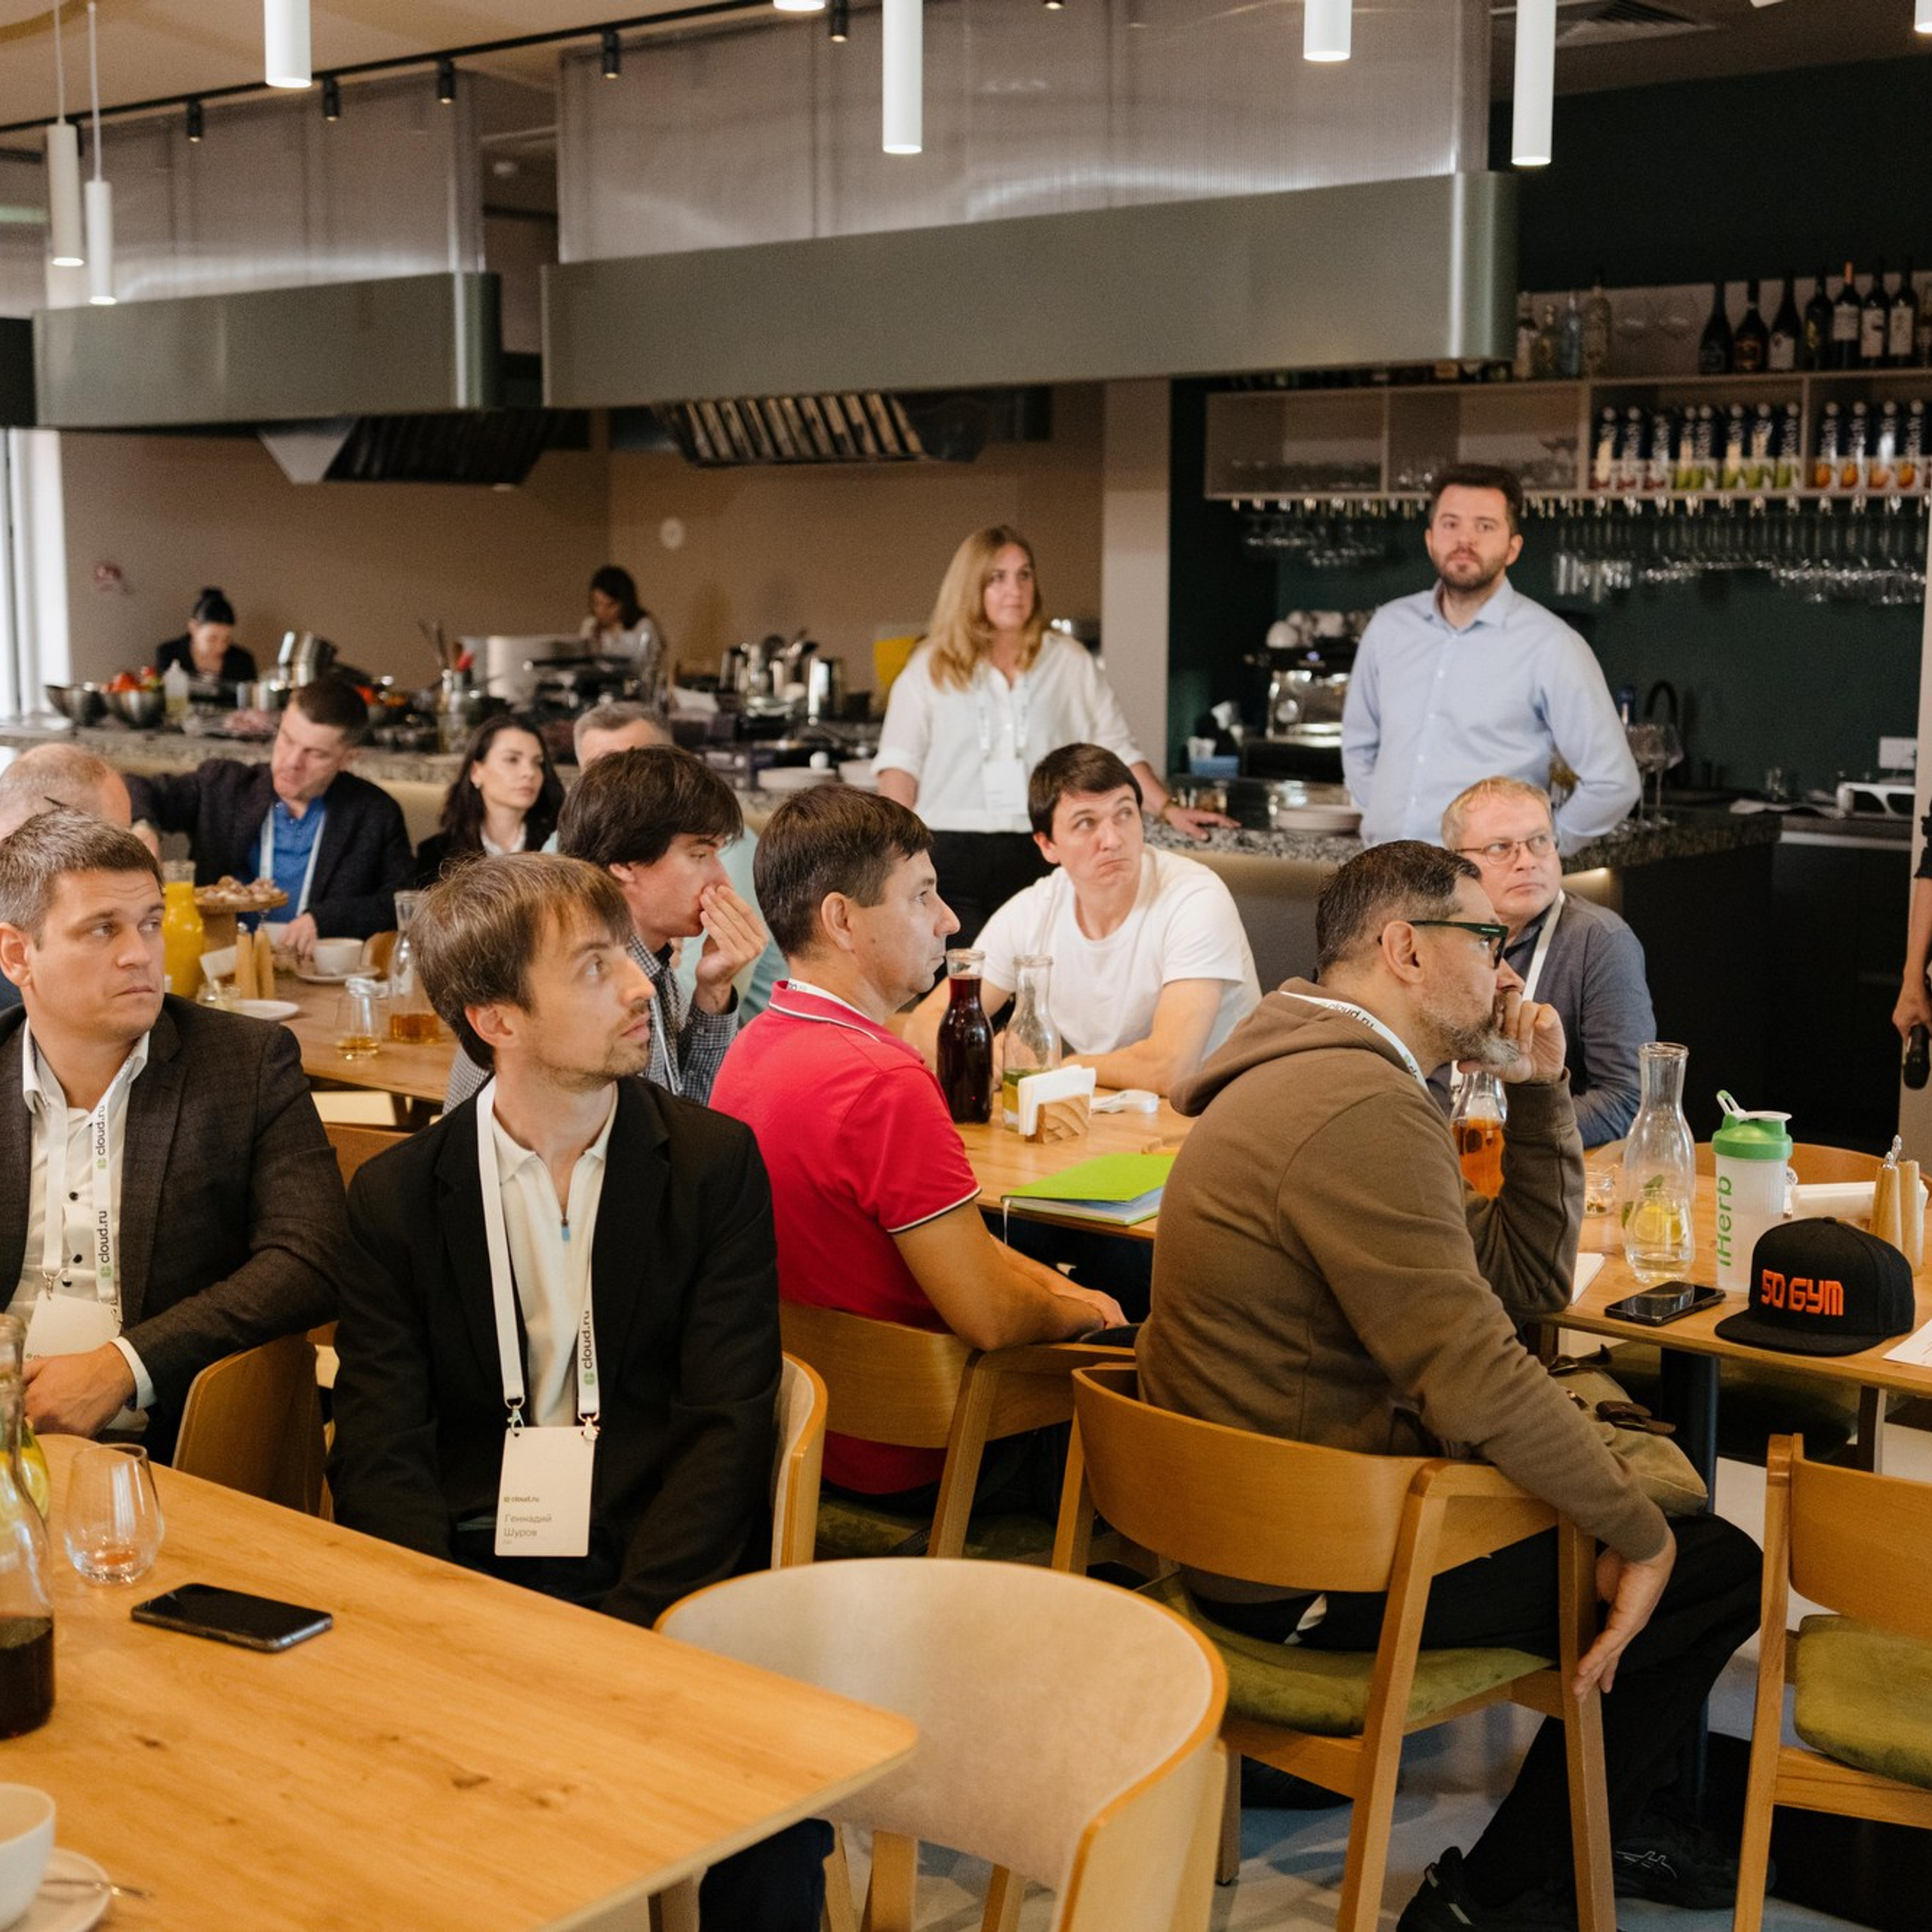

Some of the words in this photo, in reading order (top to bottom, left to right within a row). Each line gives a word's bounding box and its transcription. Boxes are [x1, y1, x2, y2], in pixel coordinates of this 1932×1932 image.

[96, 1105, 106, 1155] cloud.ru
[97, 1211, 110, 1263] cloud.ru
[1717, 1176, 1732, 1267] iHerb
[1789, 1277, 1844, 1315] GYM
[581, 1310, 593, 1369] cloud.ru
[503, 1527, 538, 1540] Шуров
[504, 1513, 552, 1524] Геннадий
